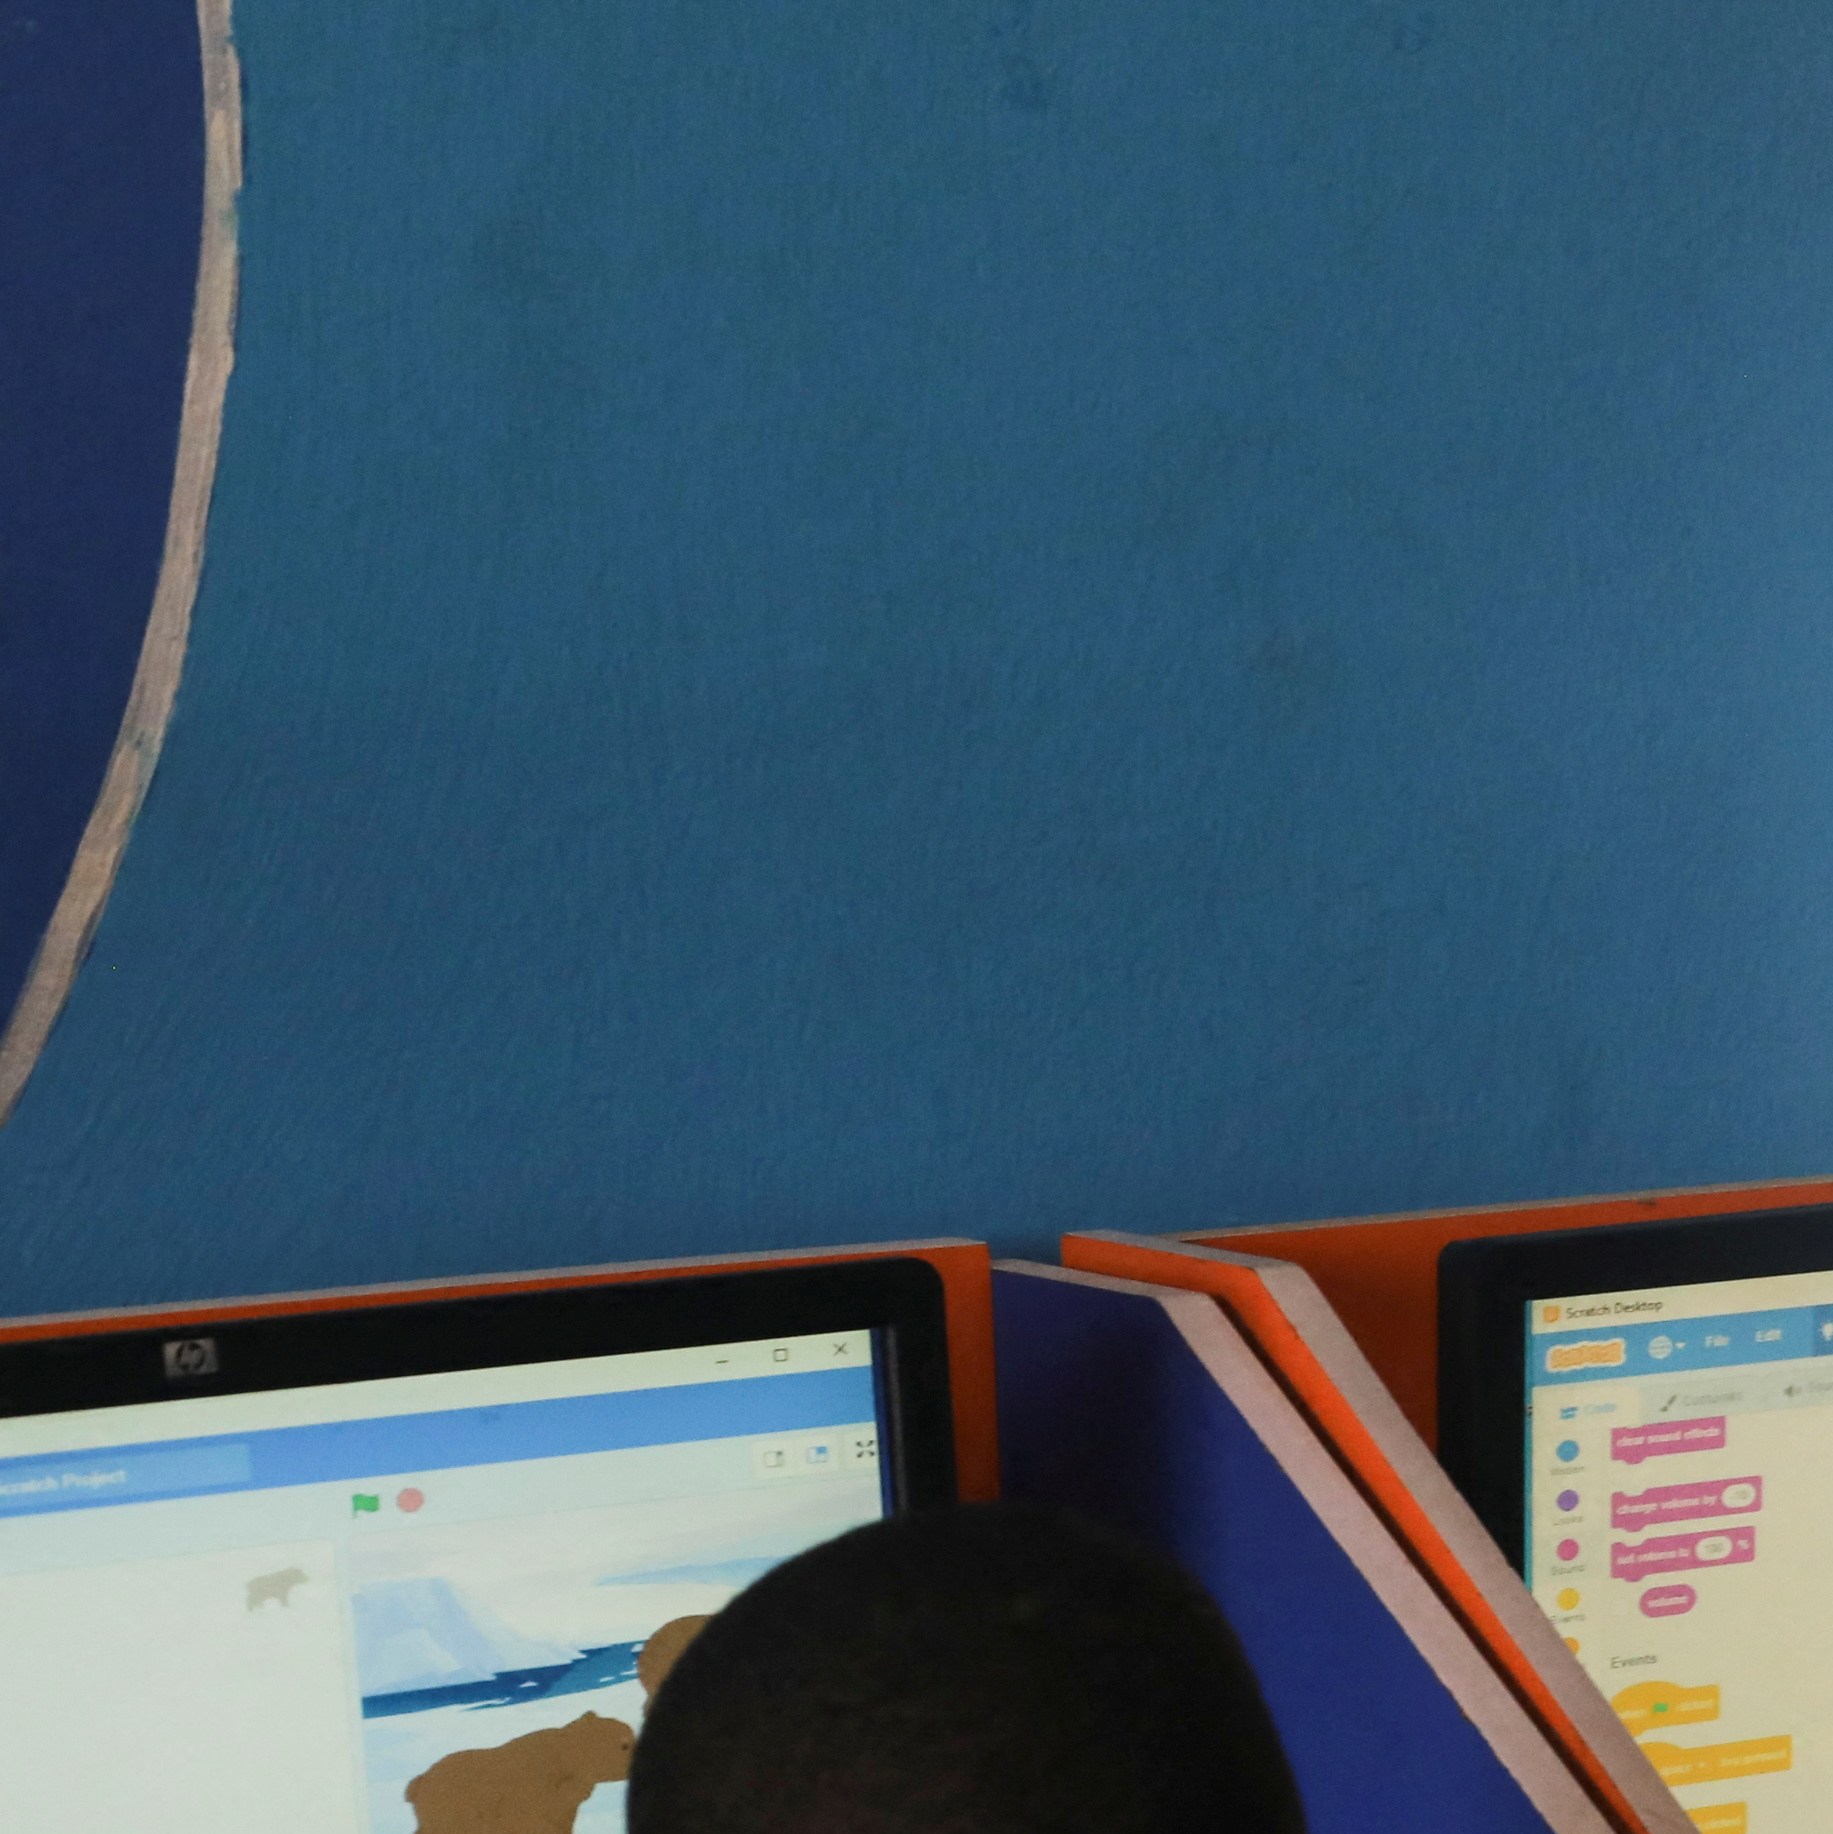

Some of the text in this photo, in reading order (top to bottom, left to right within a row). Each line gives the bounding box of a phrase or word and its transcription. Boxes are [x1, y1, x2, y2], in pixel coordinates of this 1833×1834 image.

[1566, 1299, 1664, 1320] Scratch Desktop
[1610, 1653, 1658, 1670] Events
